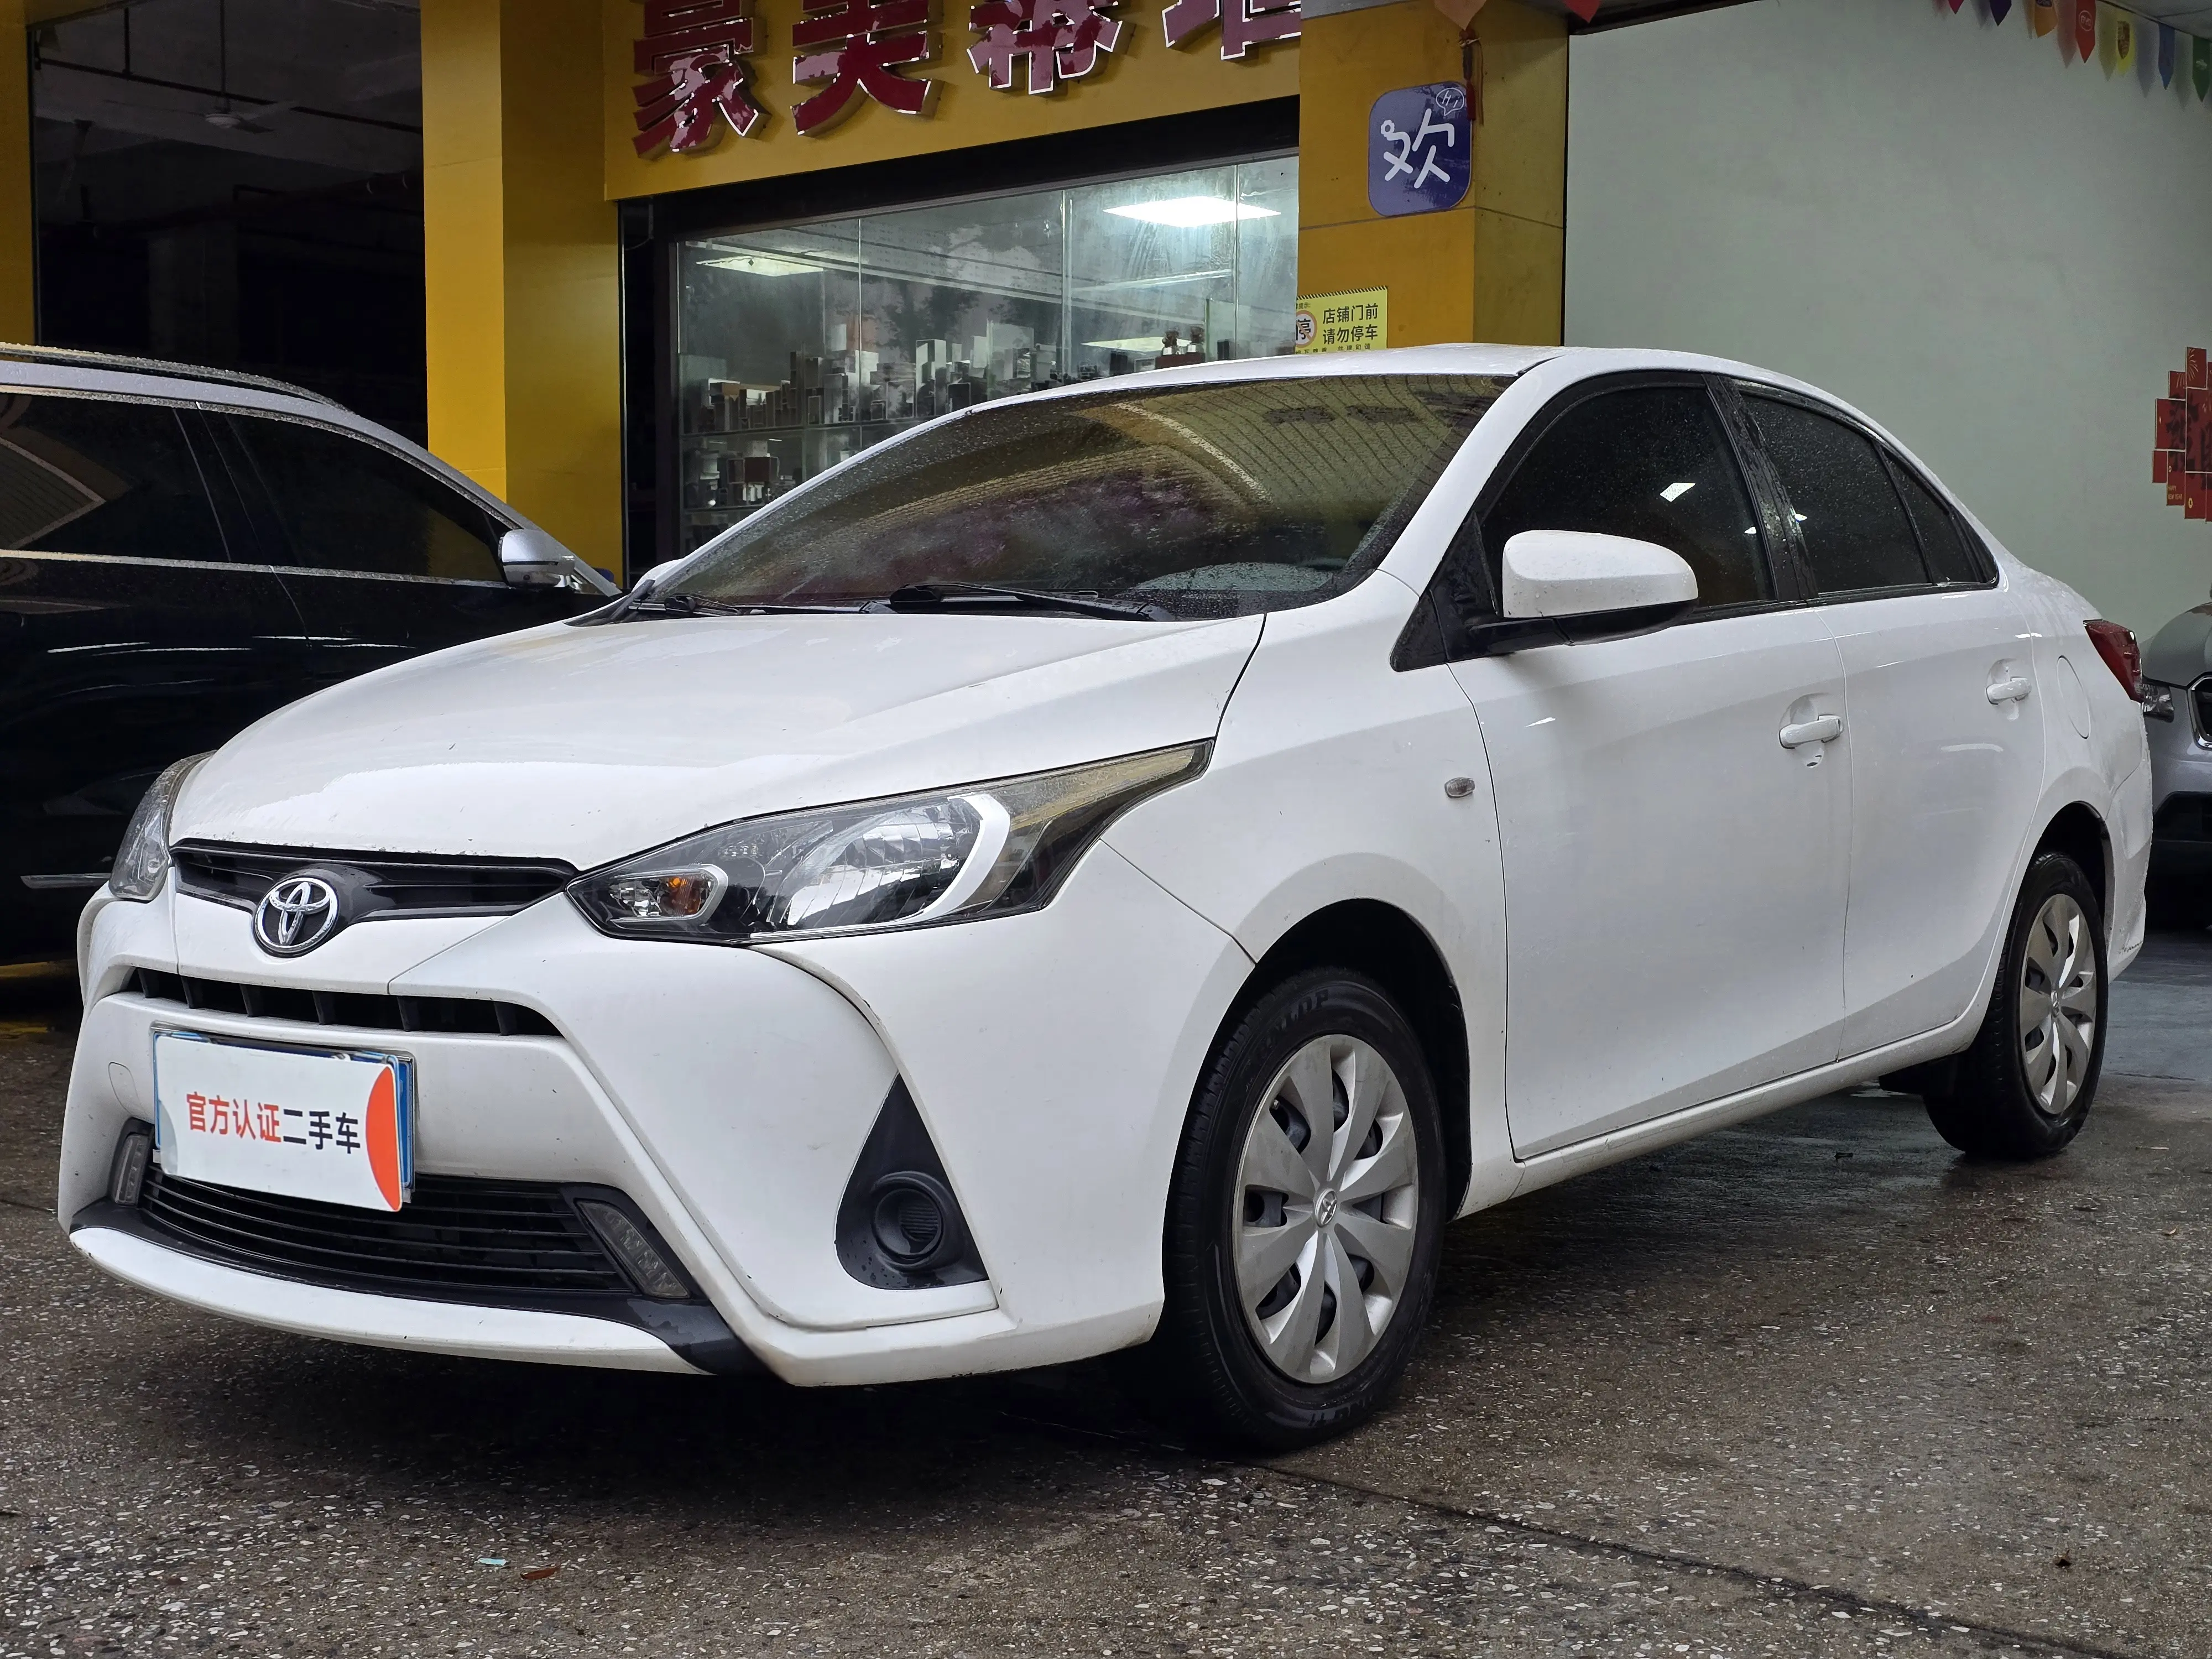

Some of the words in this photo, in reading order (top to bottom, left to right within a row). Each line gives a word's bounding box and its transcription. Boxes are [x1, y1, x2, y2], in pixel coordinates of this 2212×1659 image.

[1442, 90, 1460, 108] Hi
[1381, 108, 1455, 189] 欢
[1323, 302, 1378, 324] 店铺门前
[1323, 324, 1378, 345] 请勿停车
[186, 1092, 361, 1154] 官方认证二手车
